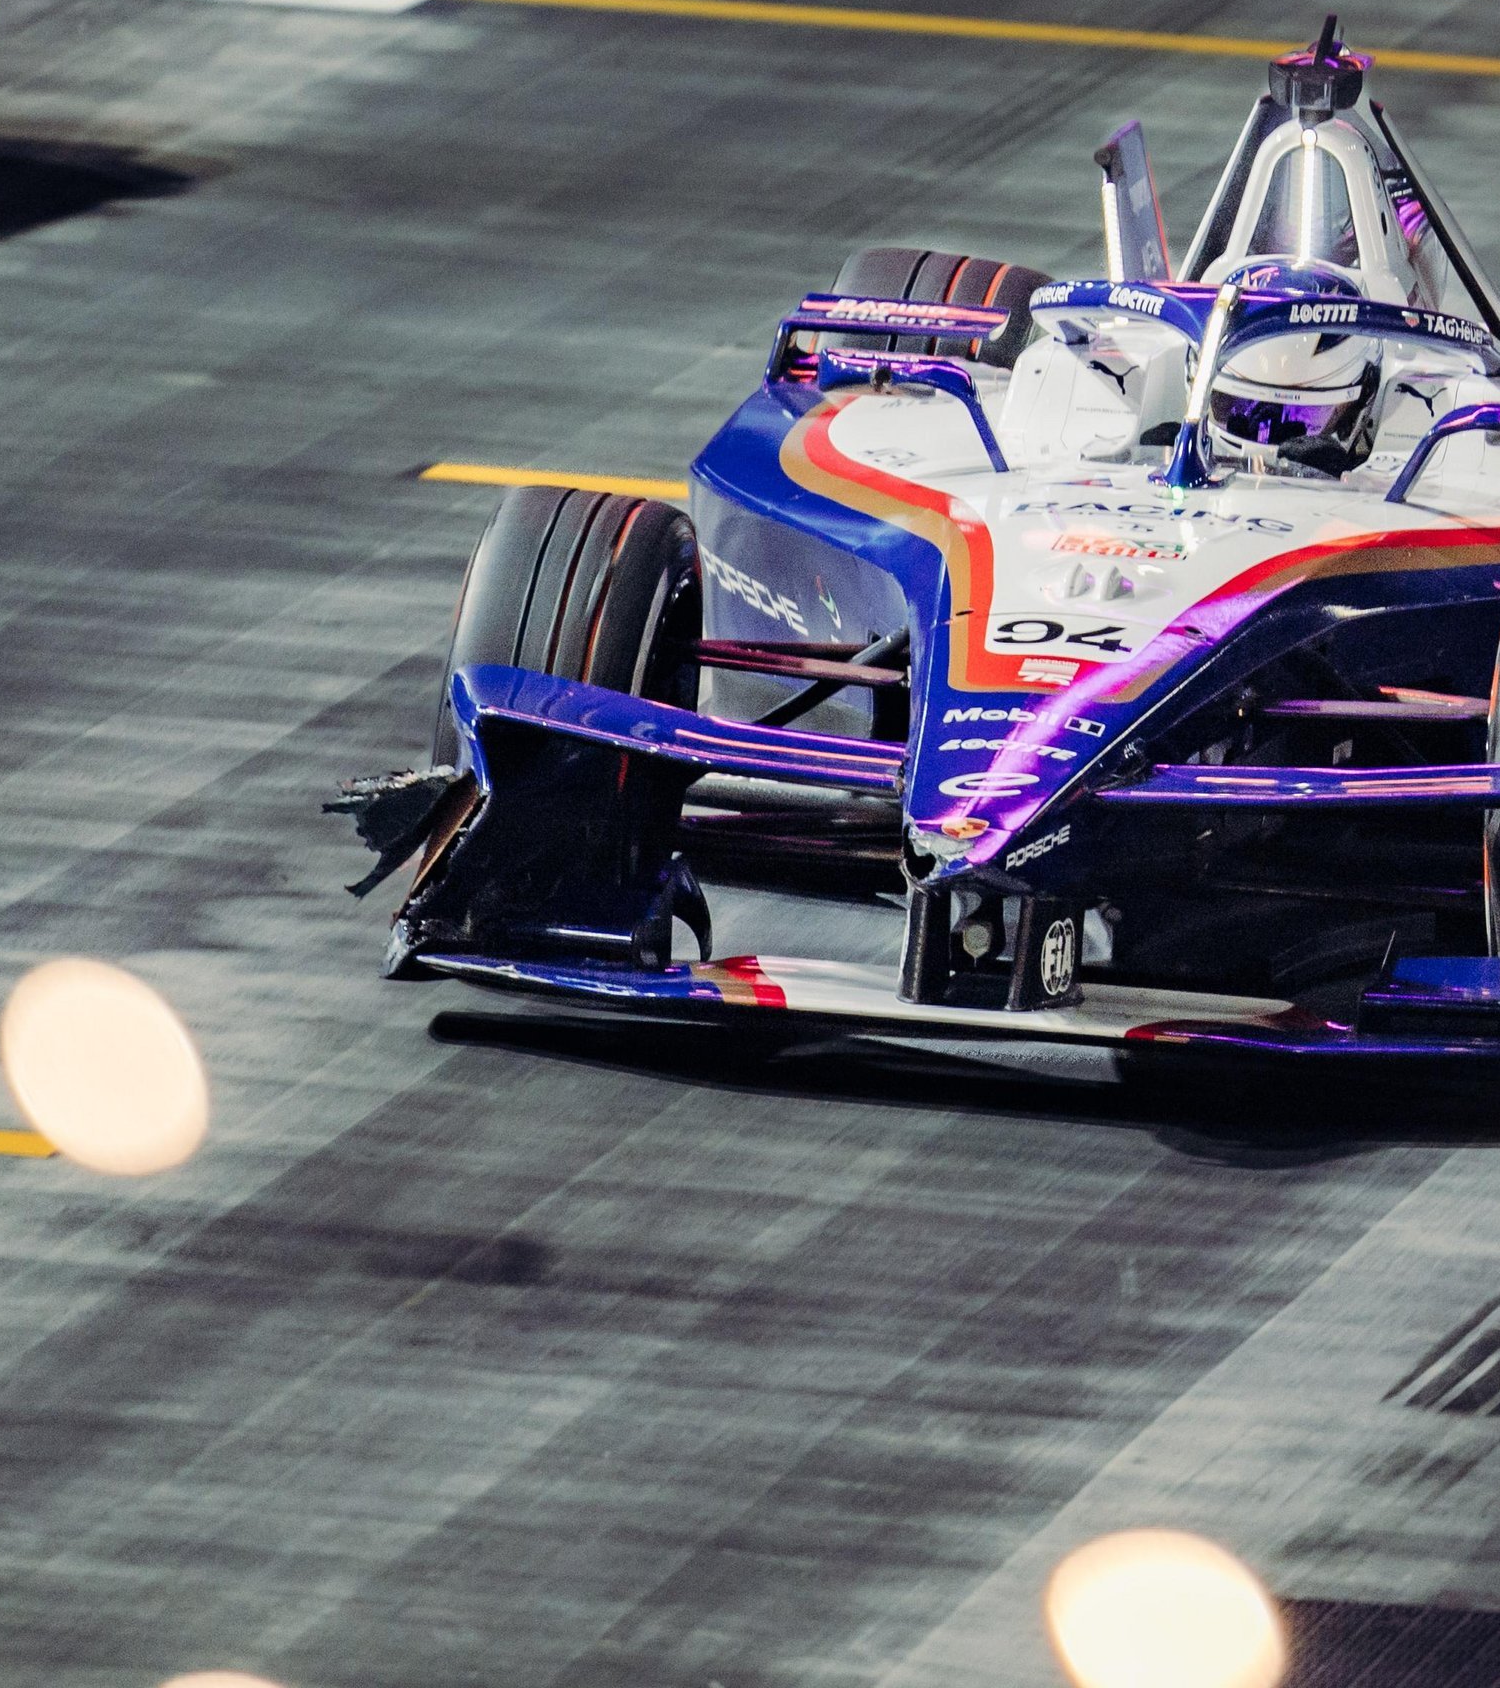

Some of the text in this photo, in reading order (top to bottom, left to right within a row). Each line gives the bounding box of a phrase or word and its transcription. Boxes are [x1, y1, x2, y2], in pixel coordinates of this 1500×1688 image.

[1108, 284, 1166, 317] LOCTITE
[1289, 304, 1359, 324] LOCTITE
[700, 543, 810, 637] PORSCHE
[992, 619, 1133, 653] 94
[942, 707, 1057, 726] Mobil
[938, 738, 1078, 761] LOCTITE
[1005, 824, 1071, 871] PORSCHE
